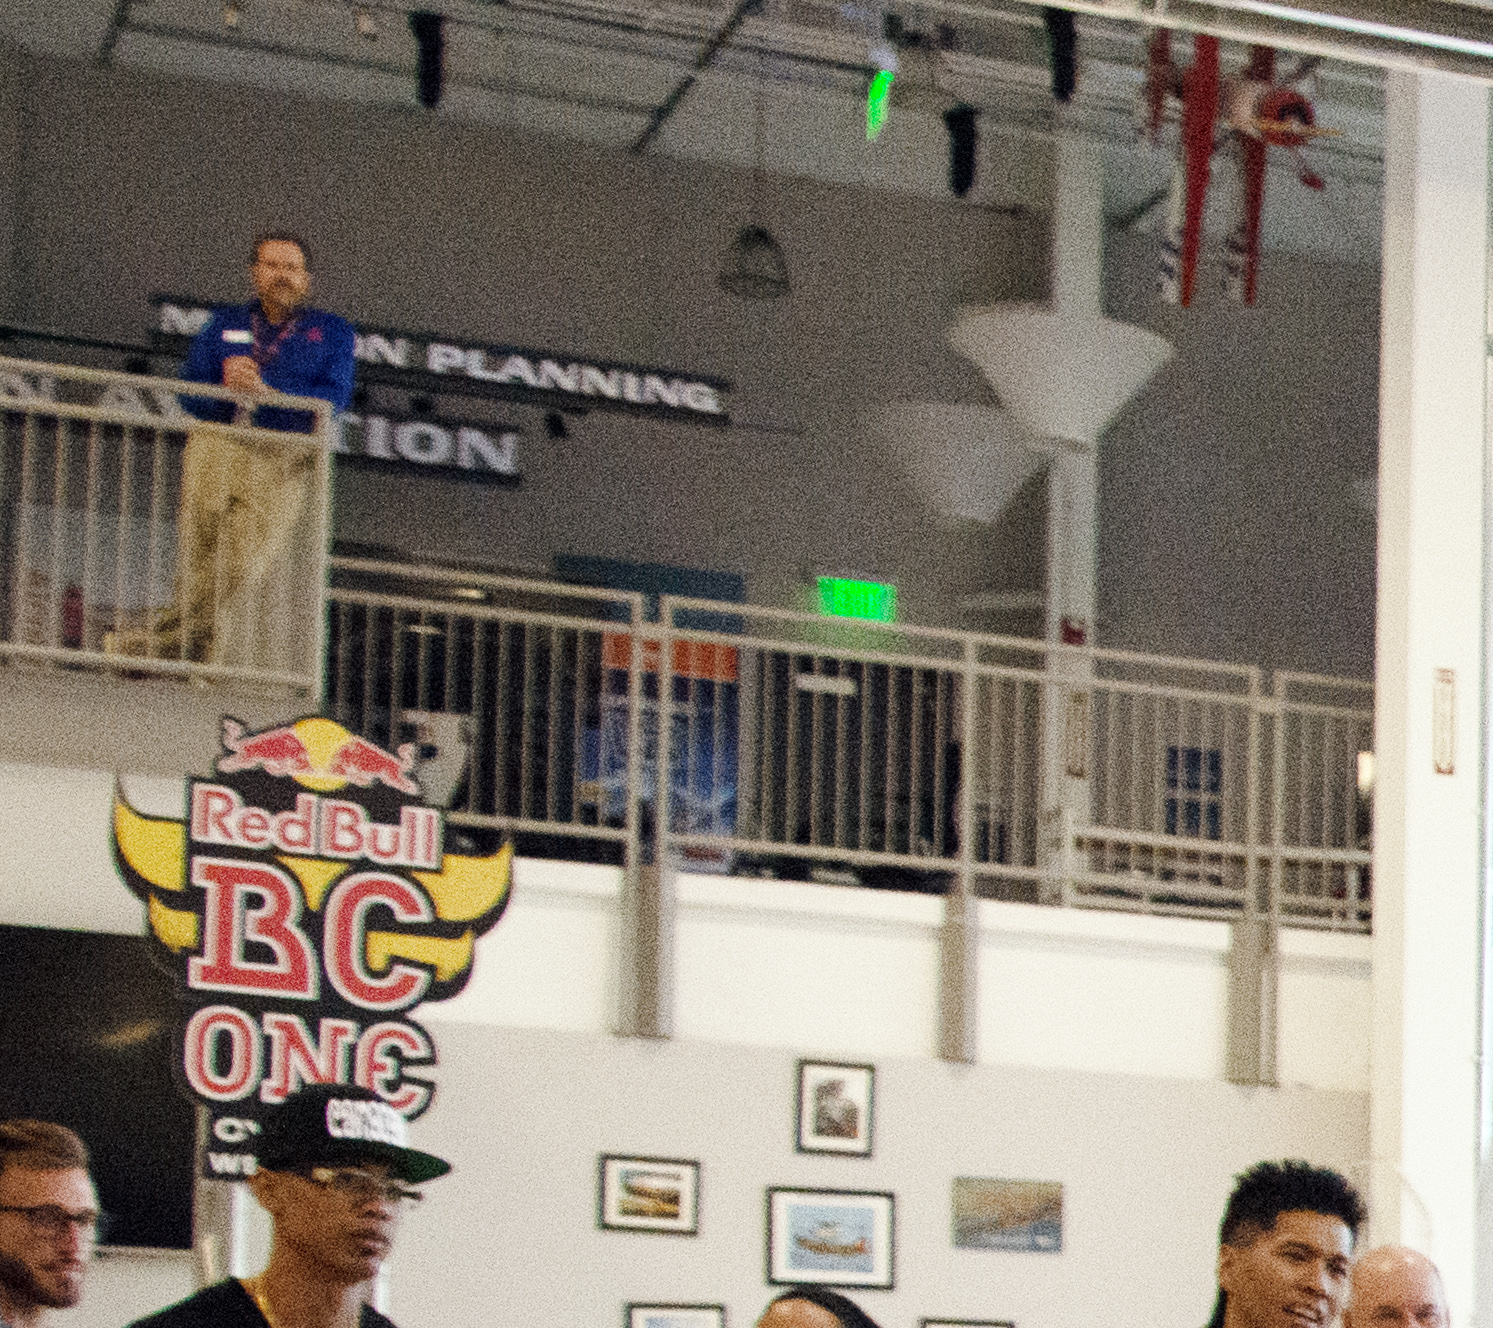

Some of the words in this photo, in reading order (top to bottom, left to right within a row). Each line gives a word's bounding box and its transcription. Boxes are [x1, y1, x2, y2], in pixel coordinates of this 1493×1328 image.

[427, 341, 723, 413] PLANNING
[187, 856, 436, 1010] BC
[183, 1004, 438, 1122] ONE
